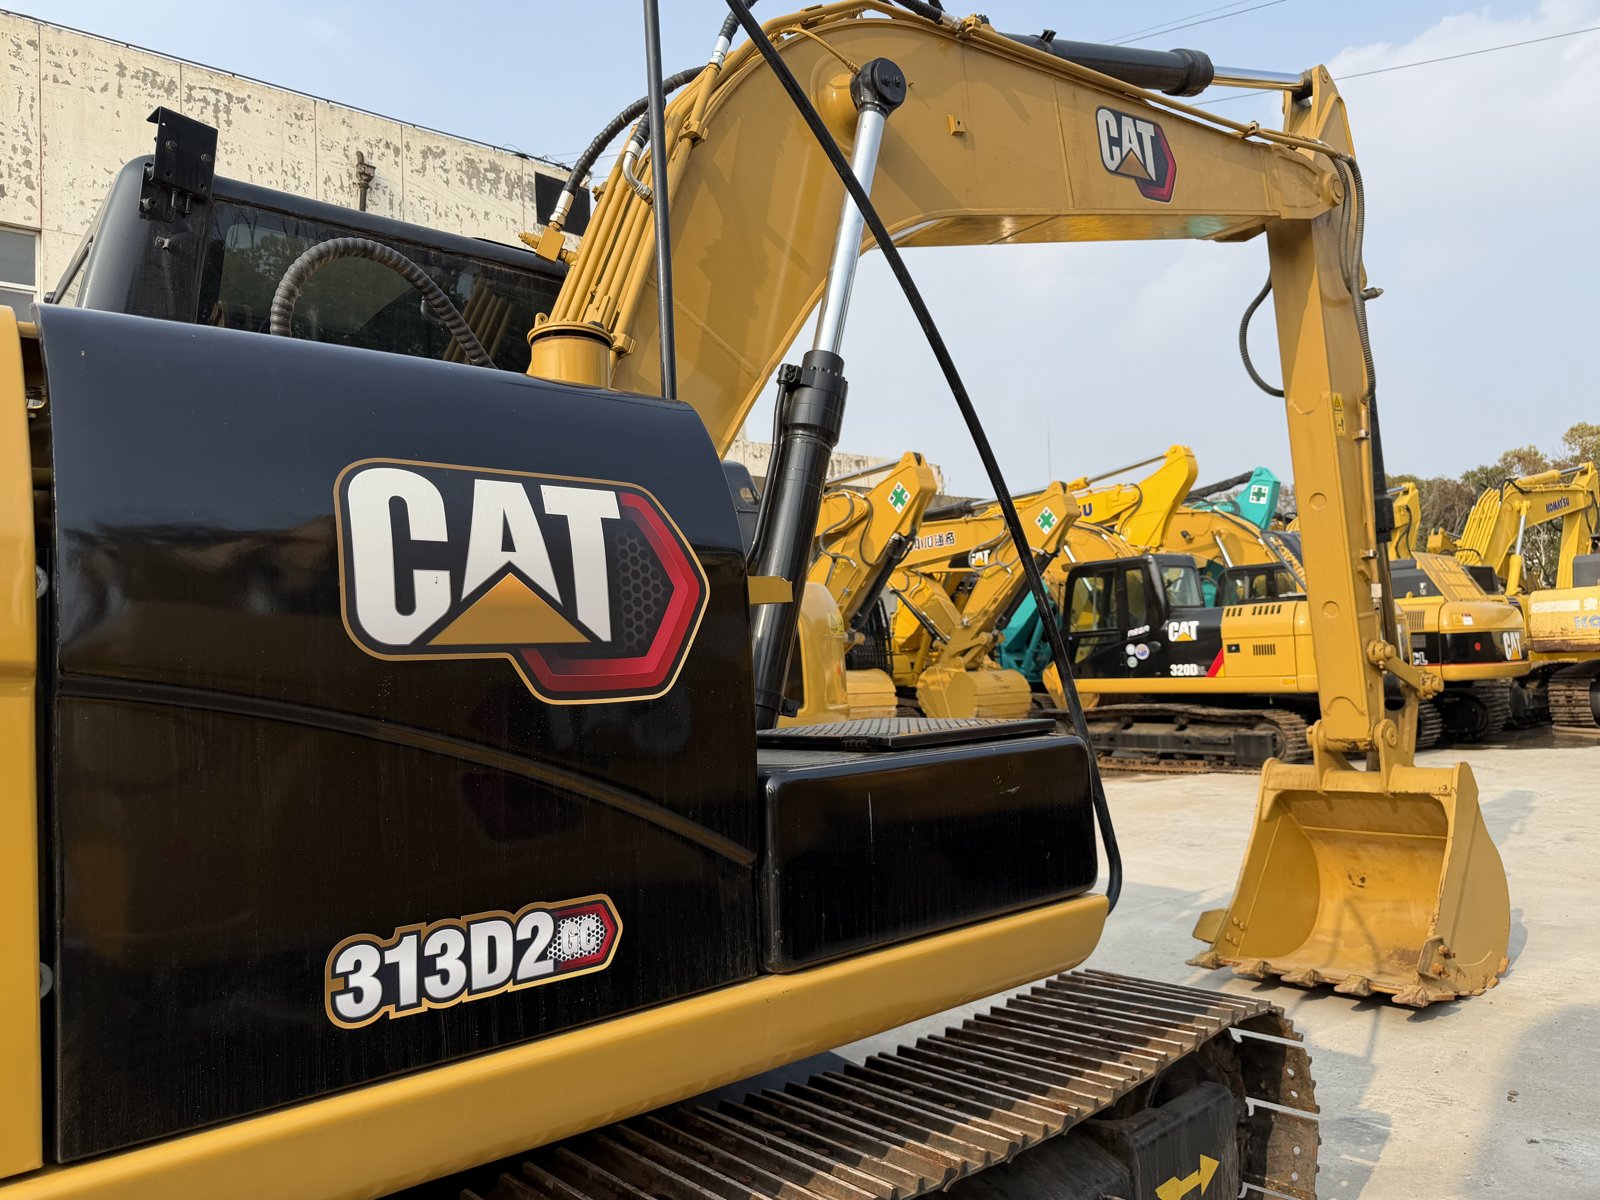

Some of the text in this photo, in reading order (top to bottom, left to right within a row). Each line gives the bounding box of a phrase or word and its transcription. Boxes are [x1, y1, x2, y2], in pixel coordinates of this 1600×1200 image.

[1097, 108, 1156, 181] CAT
[1545, 497, 1570, 514] KOMATSU
[348, 467, 621, 645] CAT
[1168, 620, 1199, 642] CAT
[1502, 632, 1522, 660] CAT
[1170, 663, 1198, 676] 320D
[335, 911, 597, 1018] 313D2 GC
